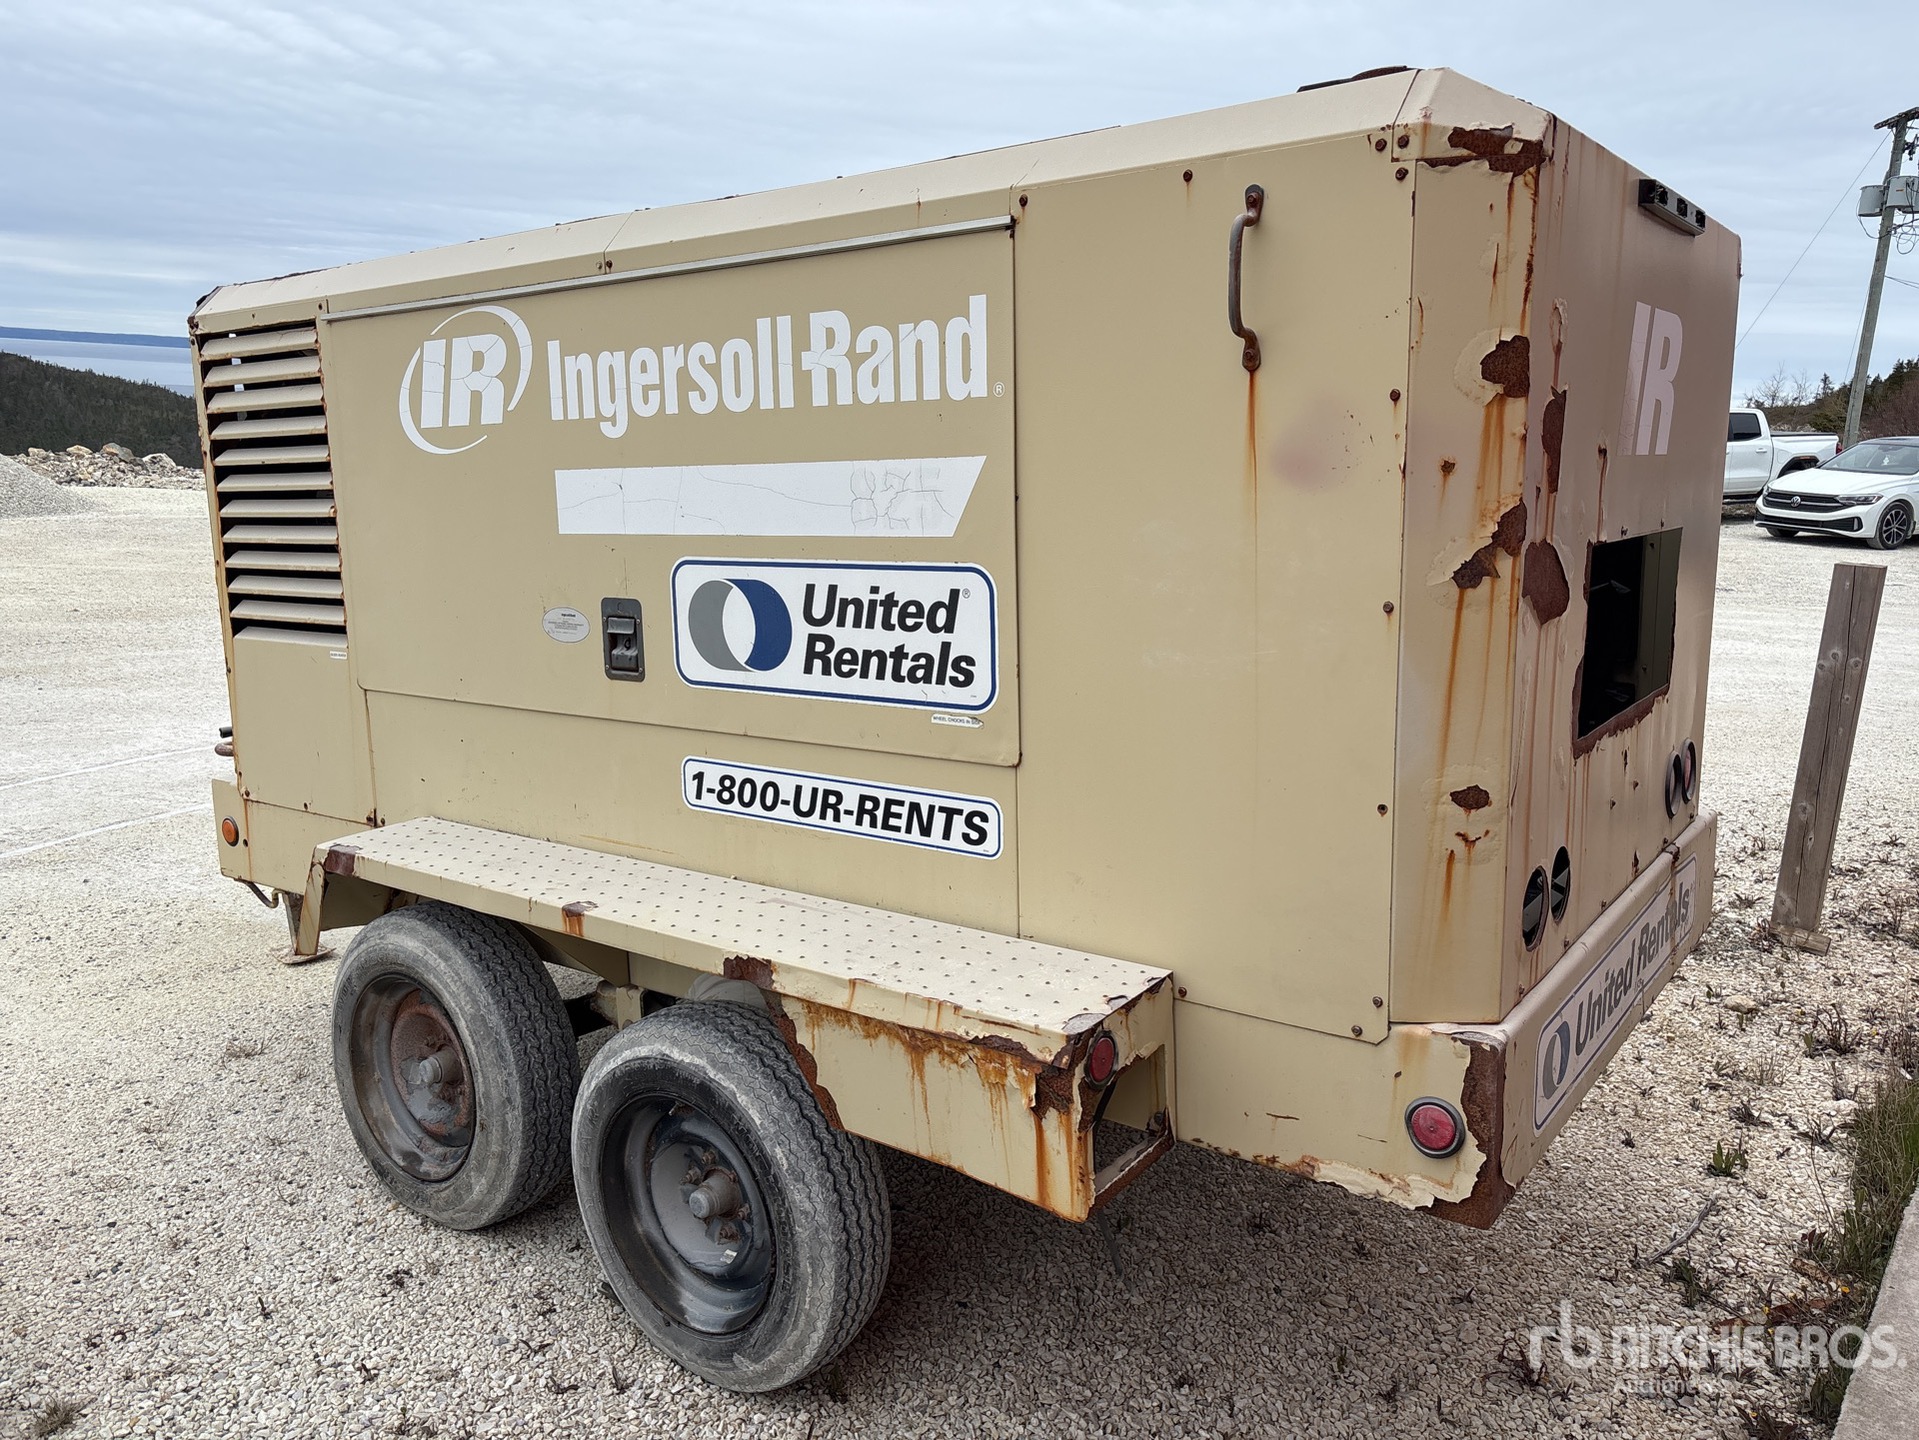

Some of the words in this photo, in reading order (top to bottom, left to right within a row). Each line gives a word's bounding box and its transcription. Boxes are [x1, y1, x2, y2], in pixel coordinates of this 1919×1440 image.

[1616, 301, 1684, 456] IR
[802, 582, 961, 634] United
[803, 633, 977, 688] Rentals
[692, 770, 989, 847] 1-800-UR-RENTS
[1575, 938, 1636, 1056] United
[1636, 881, 1690, 978] Rentals
